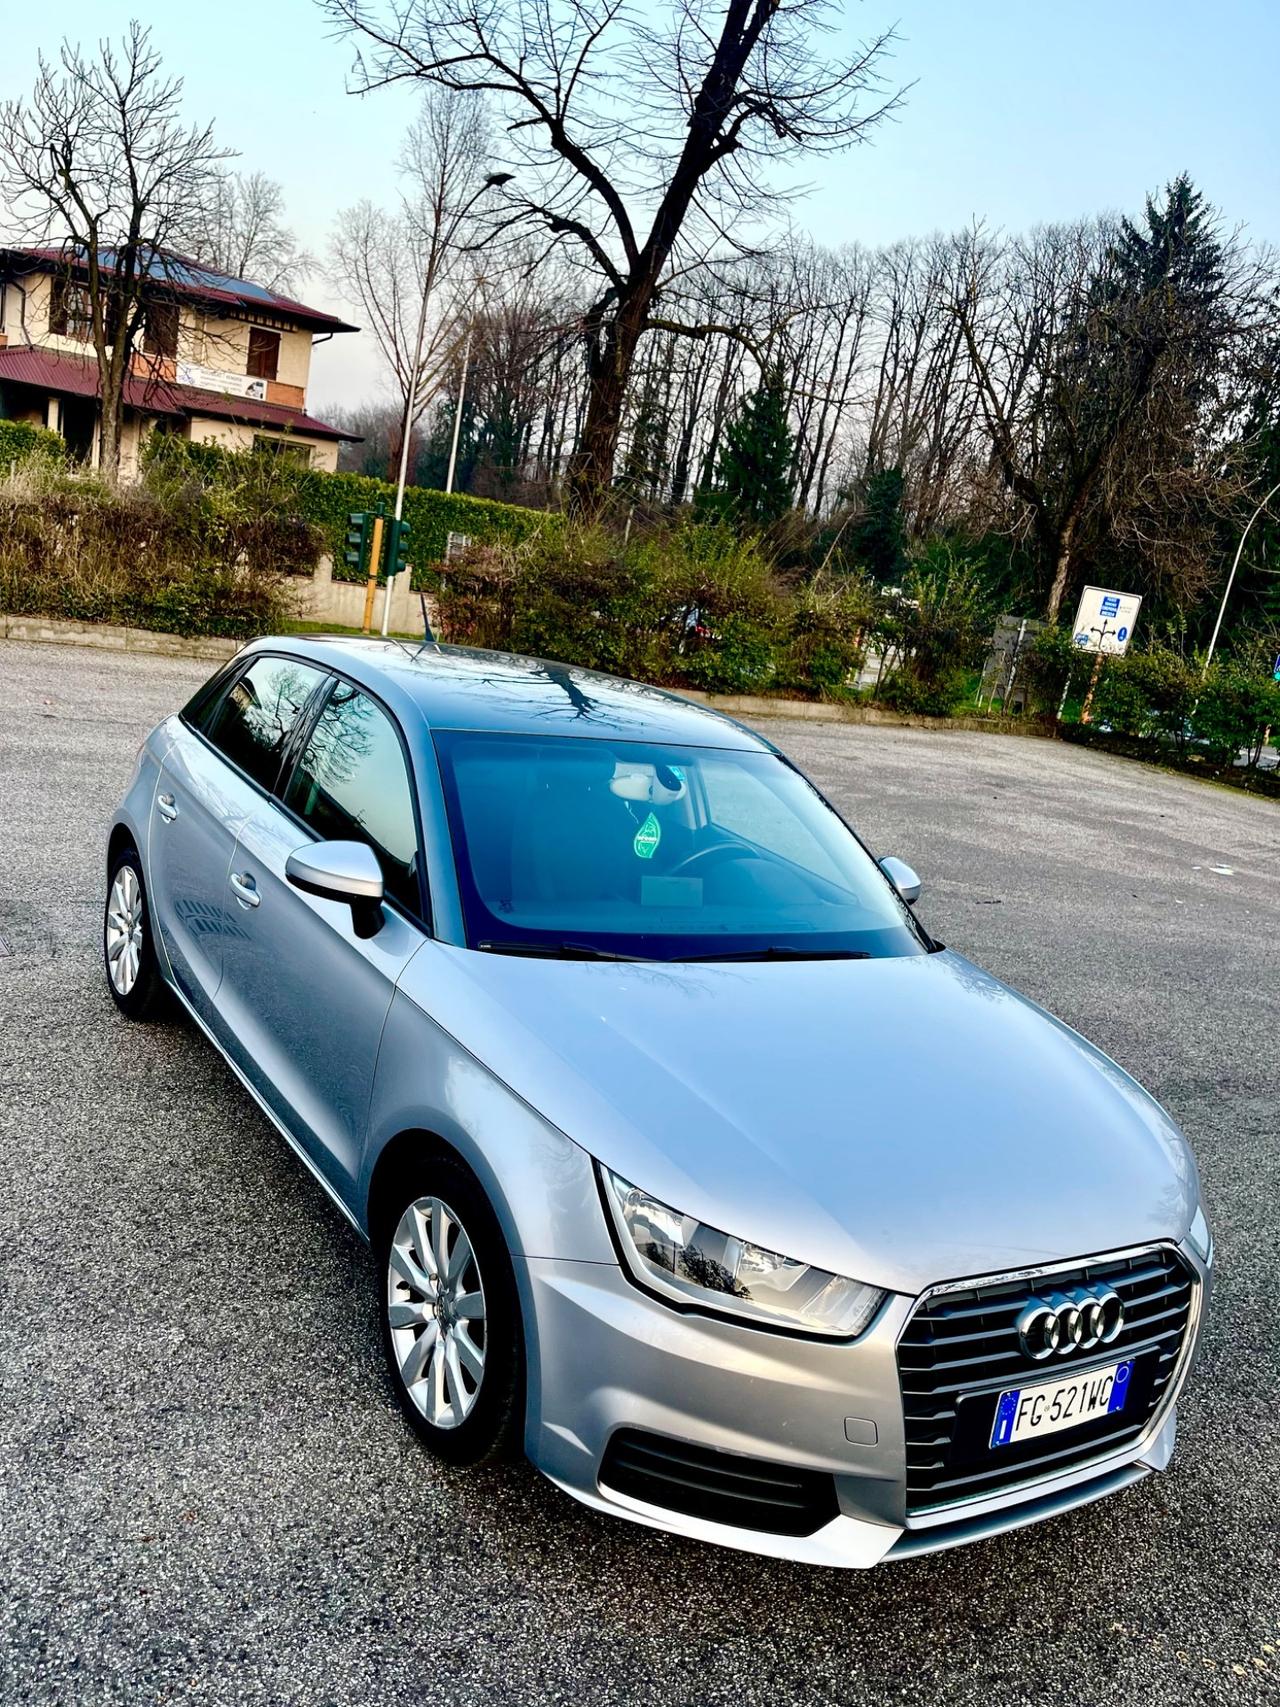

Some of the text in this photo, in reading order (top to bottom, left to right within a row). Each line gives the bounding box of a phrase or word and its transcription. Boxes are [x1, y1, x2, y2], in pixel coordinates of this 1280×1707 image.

[1015, 1375, 1114, 1431] FG 521WC
[1000, 1419, 1007, 1440] I
